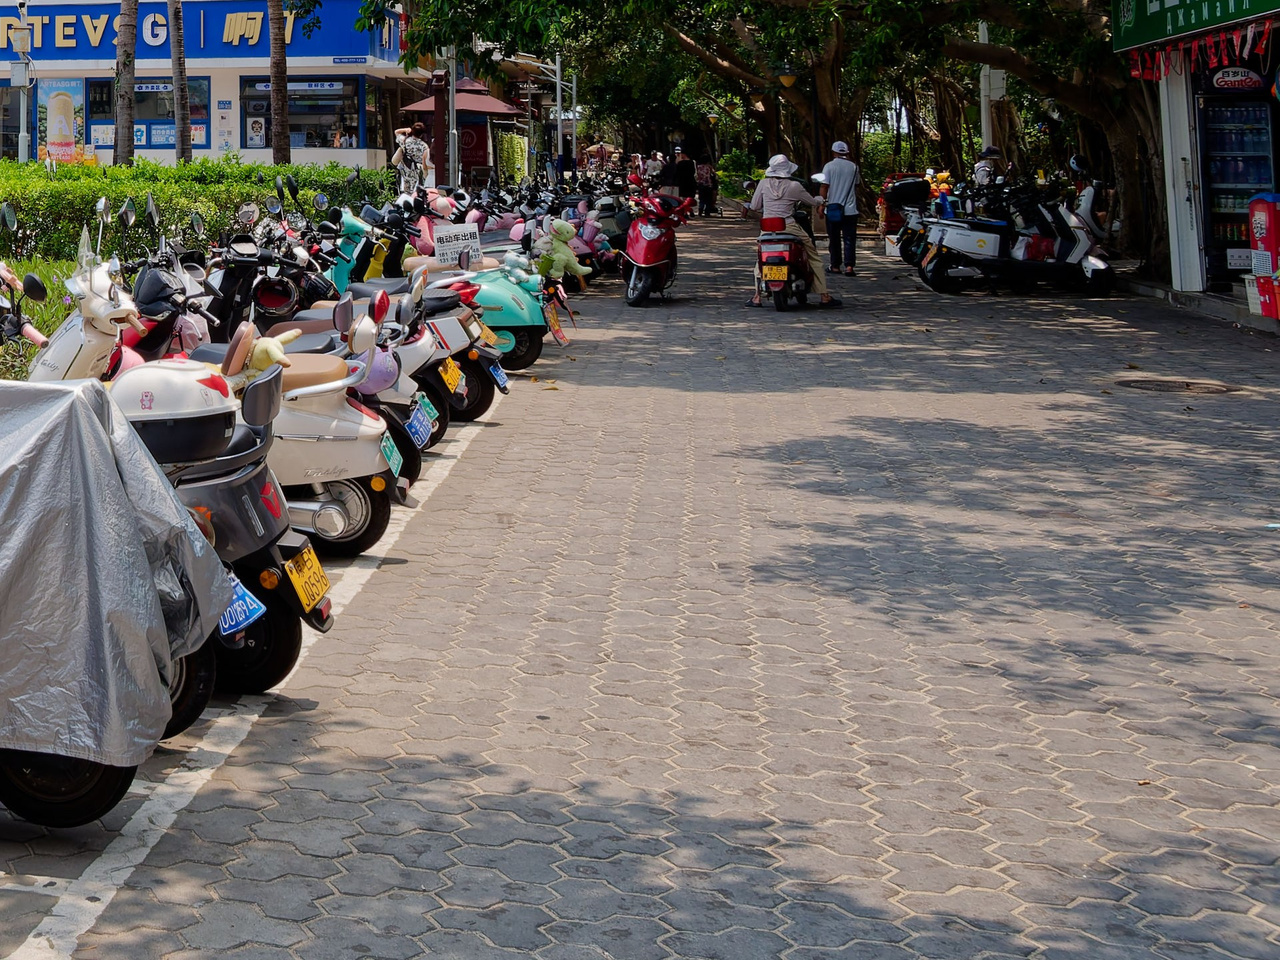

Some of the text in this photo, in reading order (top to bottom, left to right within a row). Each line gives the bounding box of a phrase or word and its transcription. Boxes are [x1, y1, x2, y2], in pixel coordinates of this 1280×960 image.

[437, 232, 477, 244] 电动车出租
